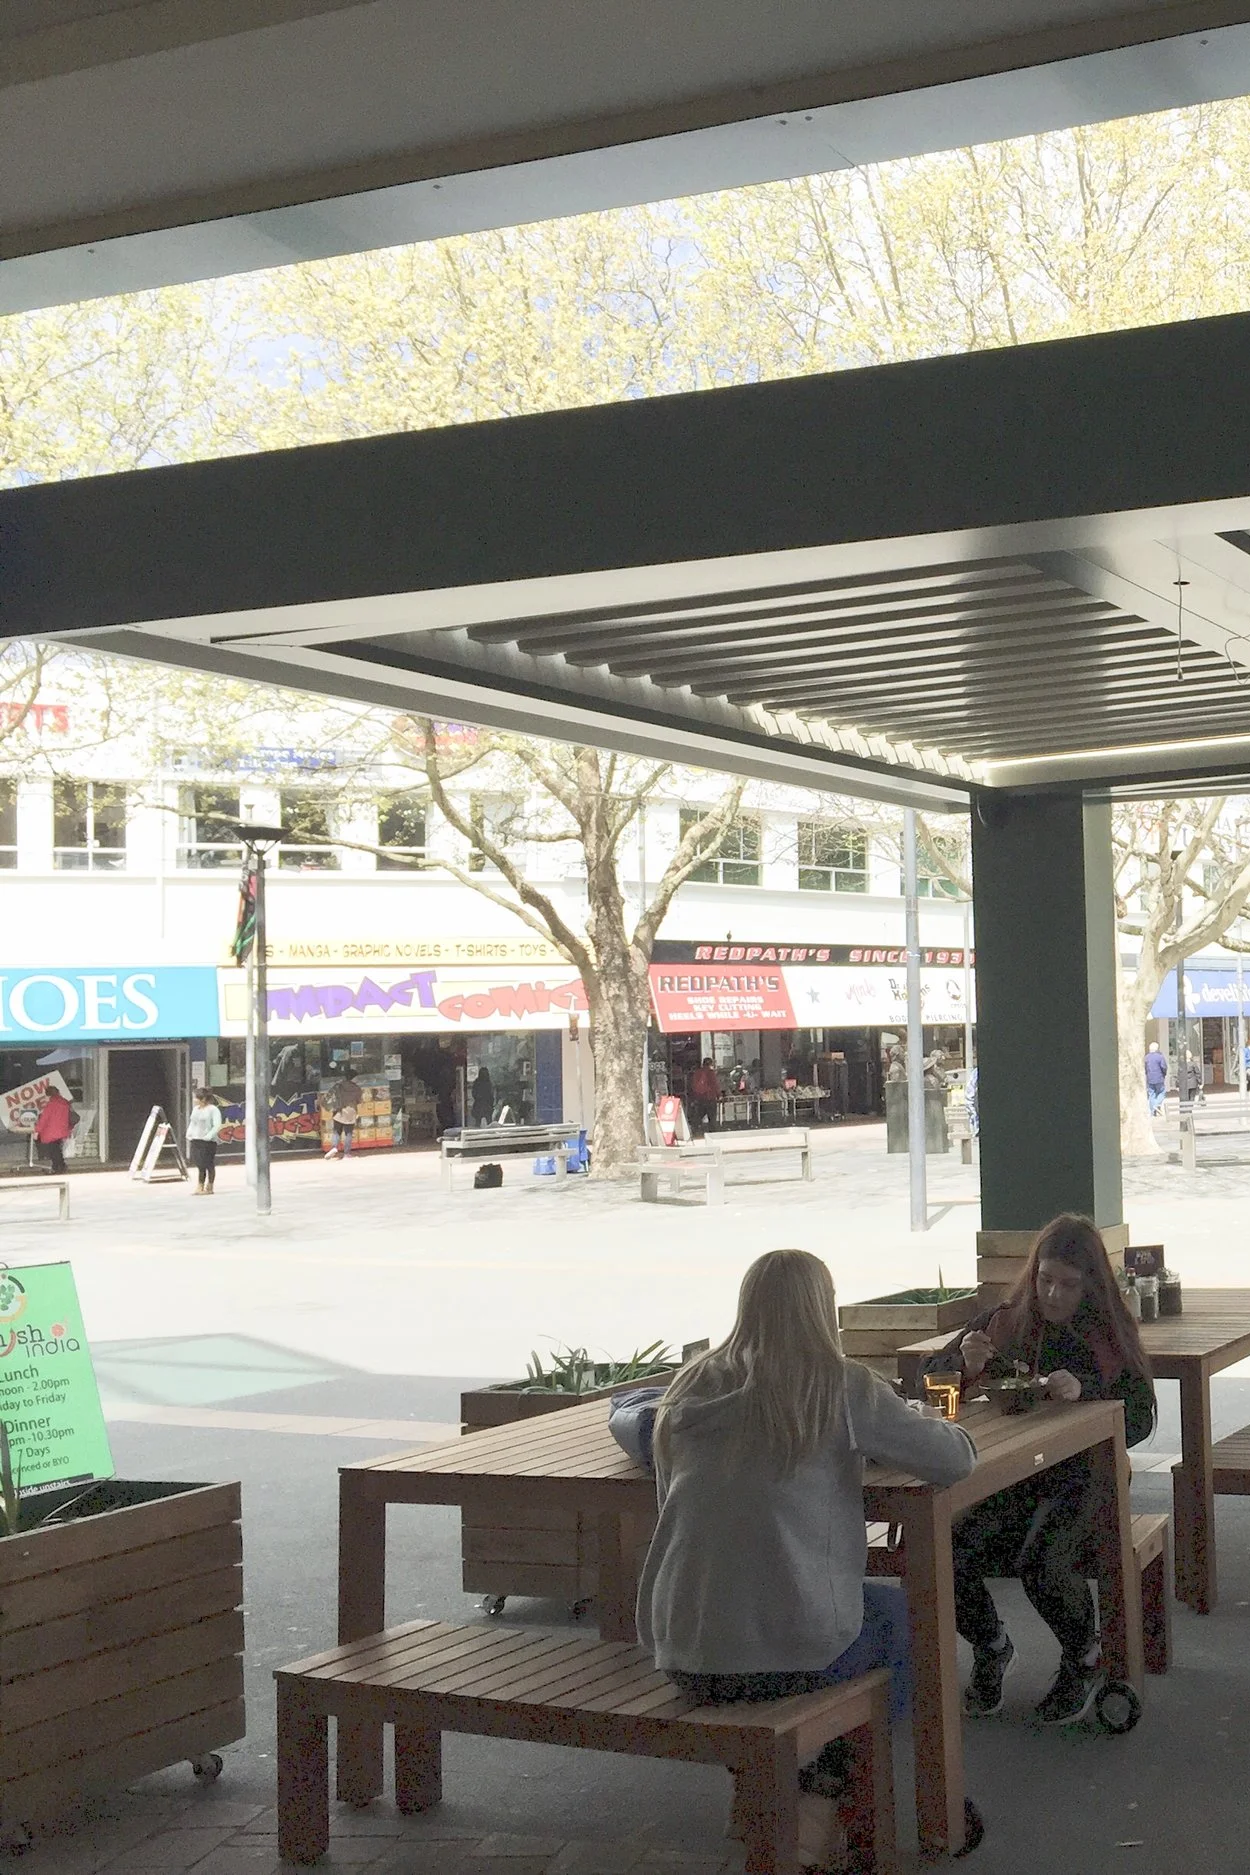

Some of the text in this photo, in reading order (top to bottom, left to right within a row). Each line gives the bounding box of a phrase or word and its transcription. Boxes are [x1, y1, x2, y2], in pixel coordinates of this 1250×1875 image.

[289, 944, 331, 958] MANGA
[343, 944, 392, 958] GRAPHIC
[395, 944, 442, 958] NOVELS
[455, 944, 508, 957] T-SHIRTS
[519, 944, 547, 957] TOYS
[693, 945, 832, 962] REDPATH'S
[657, 975, 781, 993] REDPATH'S
[686, 996, 765, 1005] SHOE REPAIRS
[692, 1003, 763, 1012] KEY CUTTING
[668, 1012, 704, 1021] HEELS
[706, 1011, 740, 1020] WHILE
[760, 1009, 788, 1018] WAIT
[925, 1013, 963, 1022] PIERCING
[5, 1078, 50, 1109] NOW
[31, 1378, 71, 1392] 2.00pm
[0, 1392, 67, 1412] day to Friday
[3, 1416, 52, 1435] Dinner
[25, 1446, 51, 1459] Days
[42, 1460, 51, 1469] or
[52, 1455, 70, 1467] BYO
